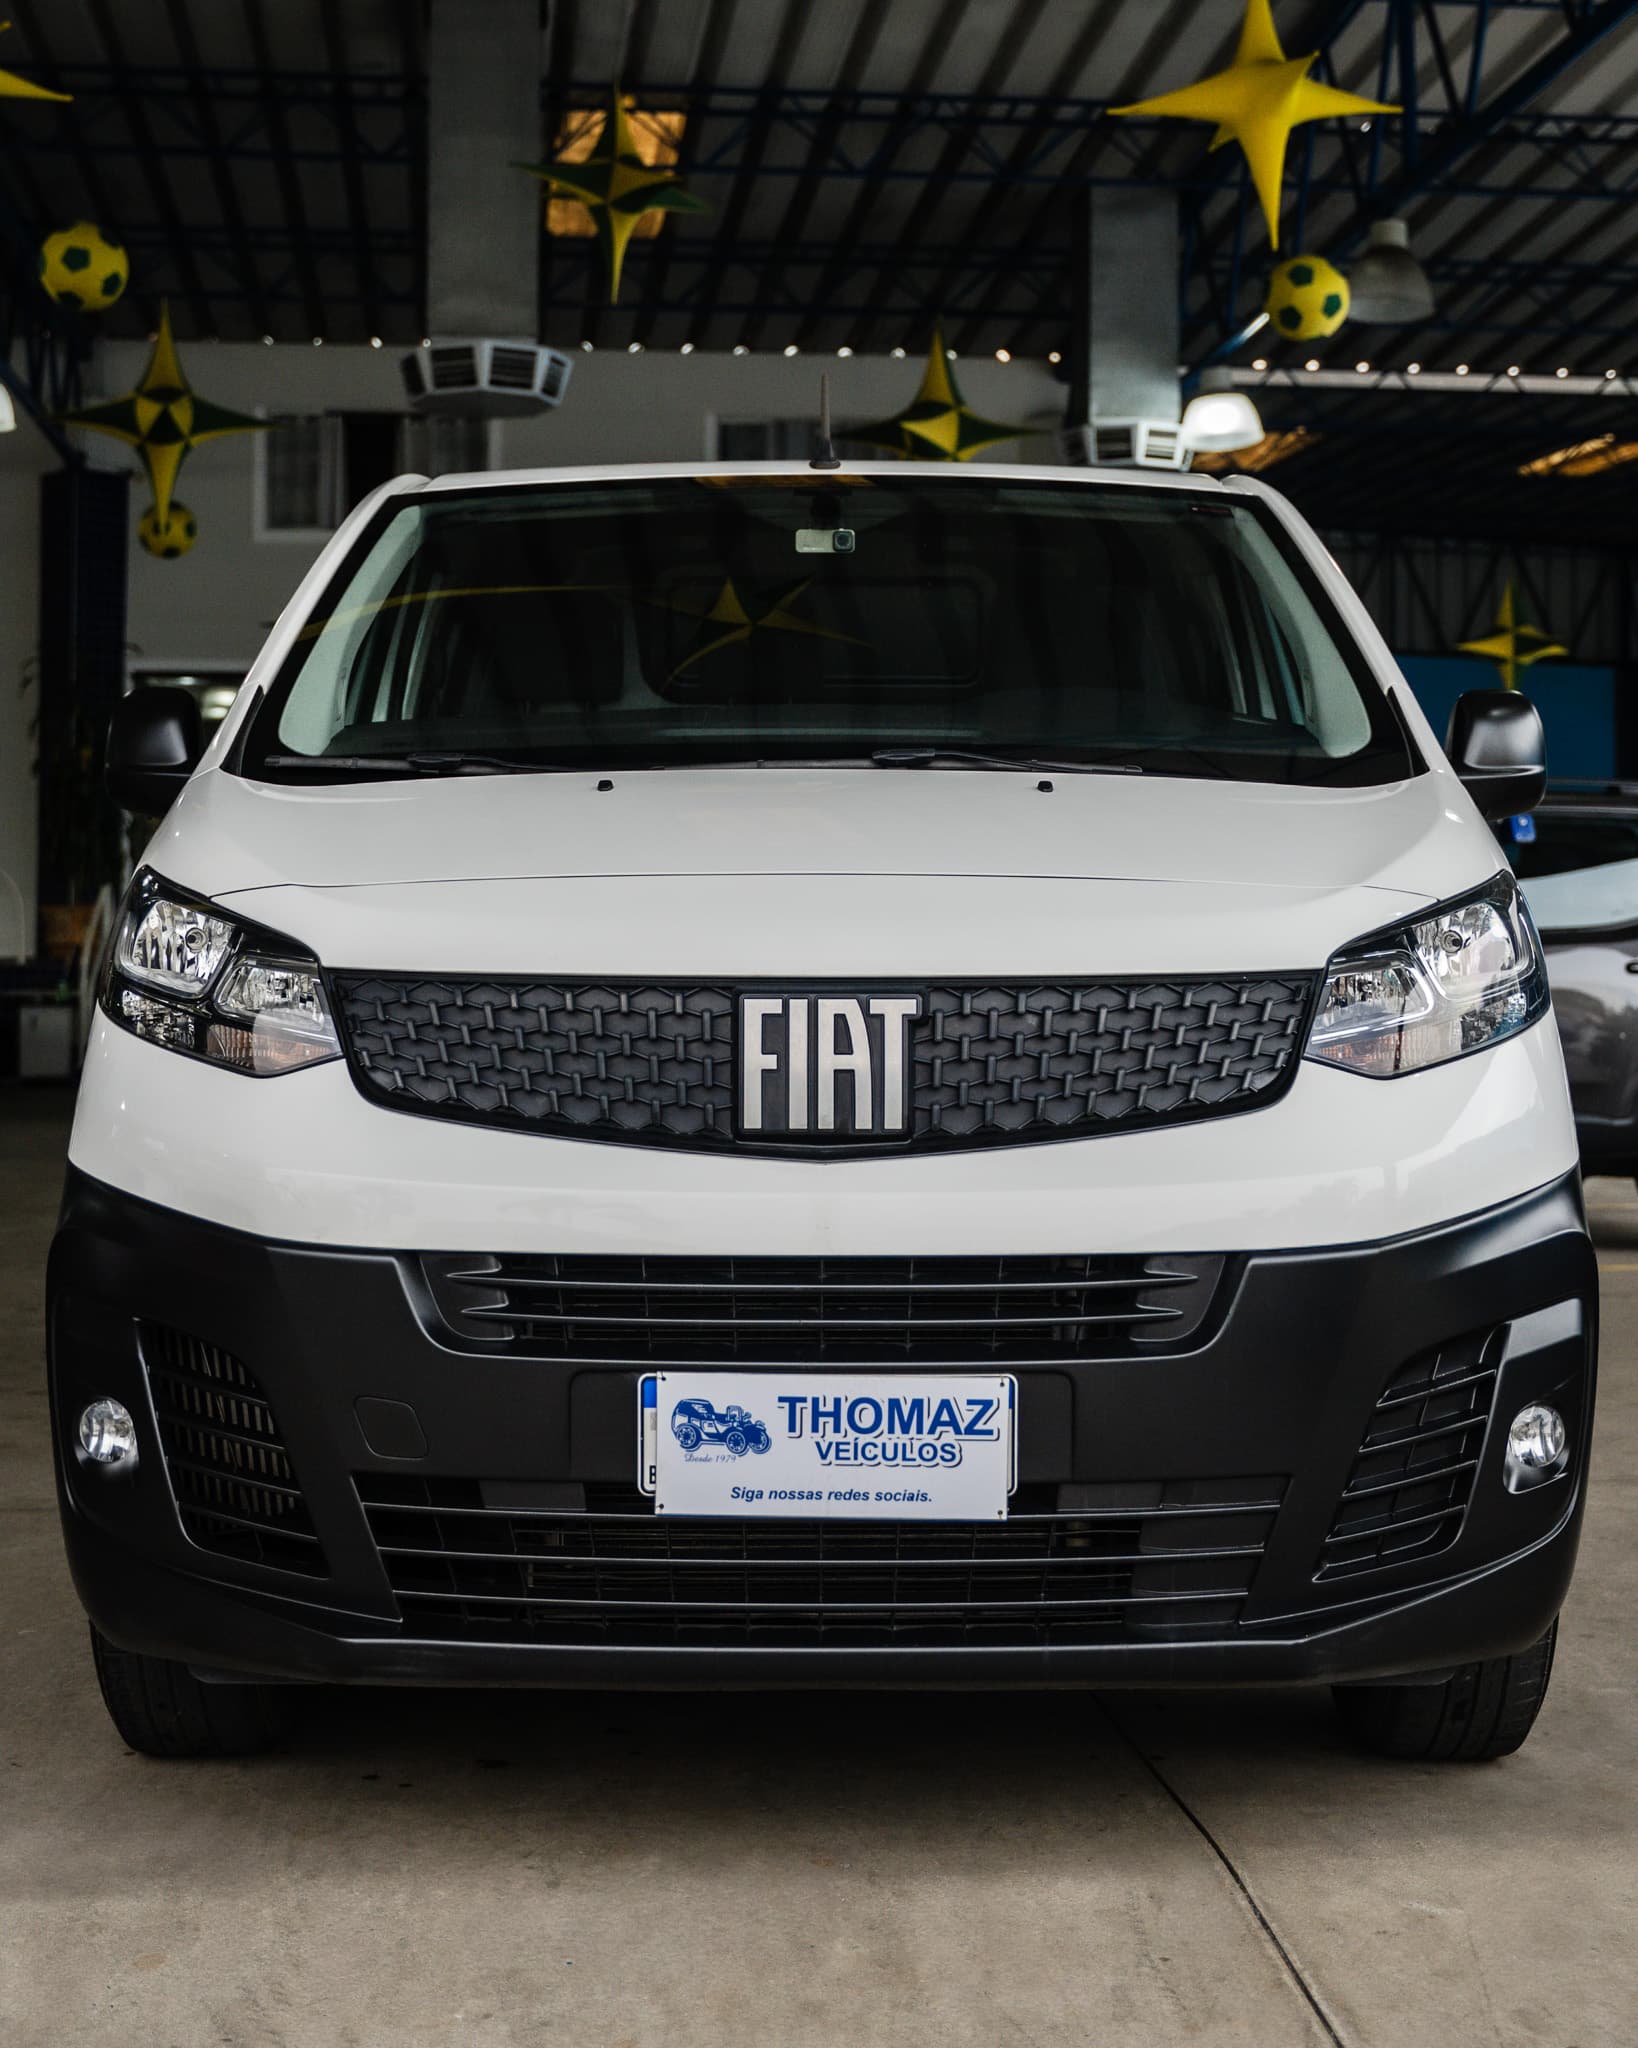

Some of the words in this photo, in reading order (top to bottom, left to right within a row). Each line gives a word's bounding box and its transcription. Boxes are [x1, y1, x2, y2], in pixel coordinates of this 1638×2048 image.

[743, 998, 917, 1130] FIAT
[777, 1395, 998, 1438] THOMAZ
[683, 1452, 712, 1463] Desde
[715, 1454, 737, 1463] 1979
[815, 1437, 960, 1466] VEÍCULOS
[730, 1486, 764, 1503] Siga
[768, 1488, 823, 1501] nossas
[827, 1489, 870, 1501] redes
[874, 1489, 932, 1503] sociais.
